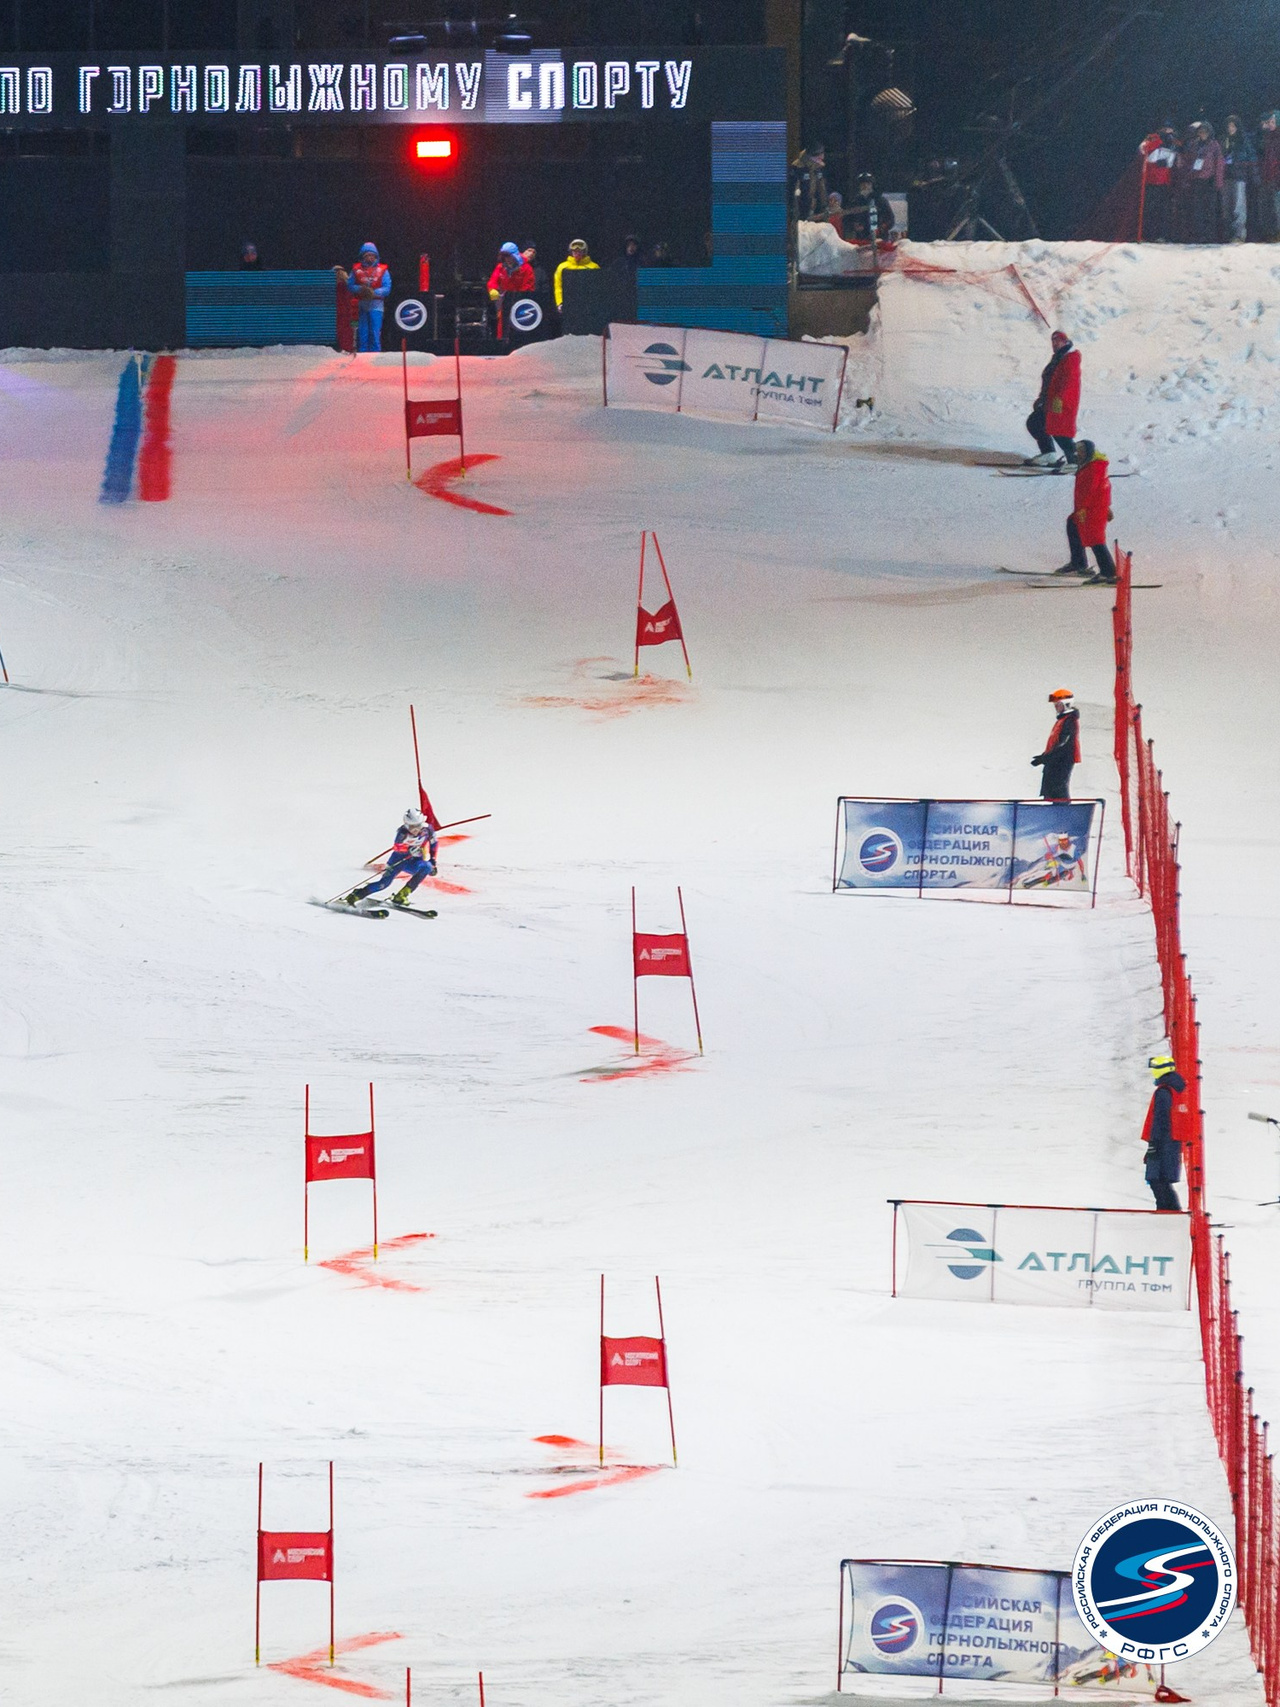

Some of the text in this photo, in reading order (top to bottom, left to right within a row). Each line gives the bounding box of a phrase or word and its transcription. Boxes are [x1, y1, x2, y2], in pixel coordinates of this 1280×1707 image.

[78, 62, 482, 113] ГОРНОЛЫЖНОМУ
[507, 60, 693, 110] СПОРТУ
[701, 363, 825, 393] АТЛАНТ
[904, 869, 957, 880] СПОРТА
[1016, 1251, 1175, 1276] АТЛАНТ
[1077, 1279, 1173, 1293] ГРУППА ТФМ
[926, 1653, 993, 1668] СПОРТА
